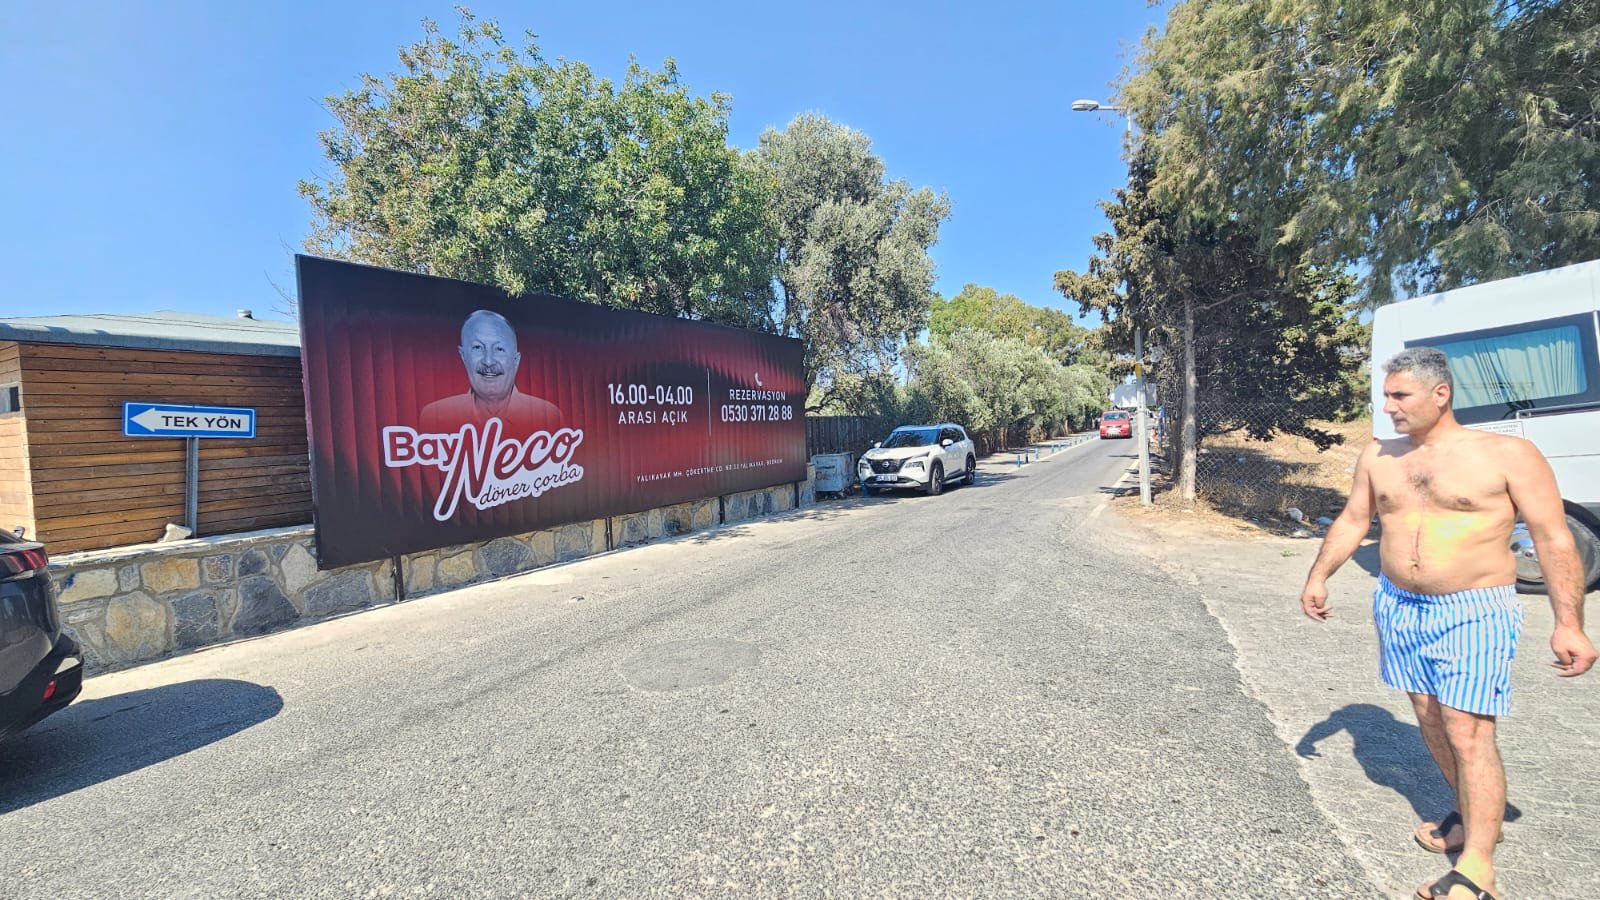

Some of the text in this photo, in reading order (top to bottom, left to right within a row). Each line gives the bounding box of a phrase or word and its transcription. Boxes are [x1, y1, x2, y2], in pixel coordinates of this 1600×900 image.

[608, 383, 693, 405] 16.00-04.00
[729, 389, 786, 401] REZERVASYON
[161, 415, 241, 429] TEK YÖN
[618, 411, 688, 426] ARASI AÇIK
[721, 404, 793, 422] 0530 371 28 88
[386, 418, 582, 519] Bay Neco
[479, 464, 581, 505] döner çorba
